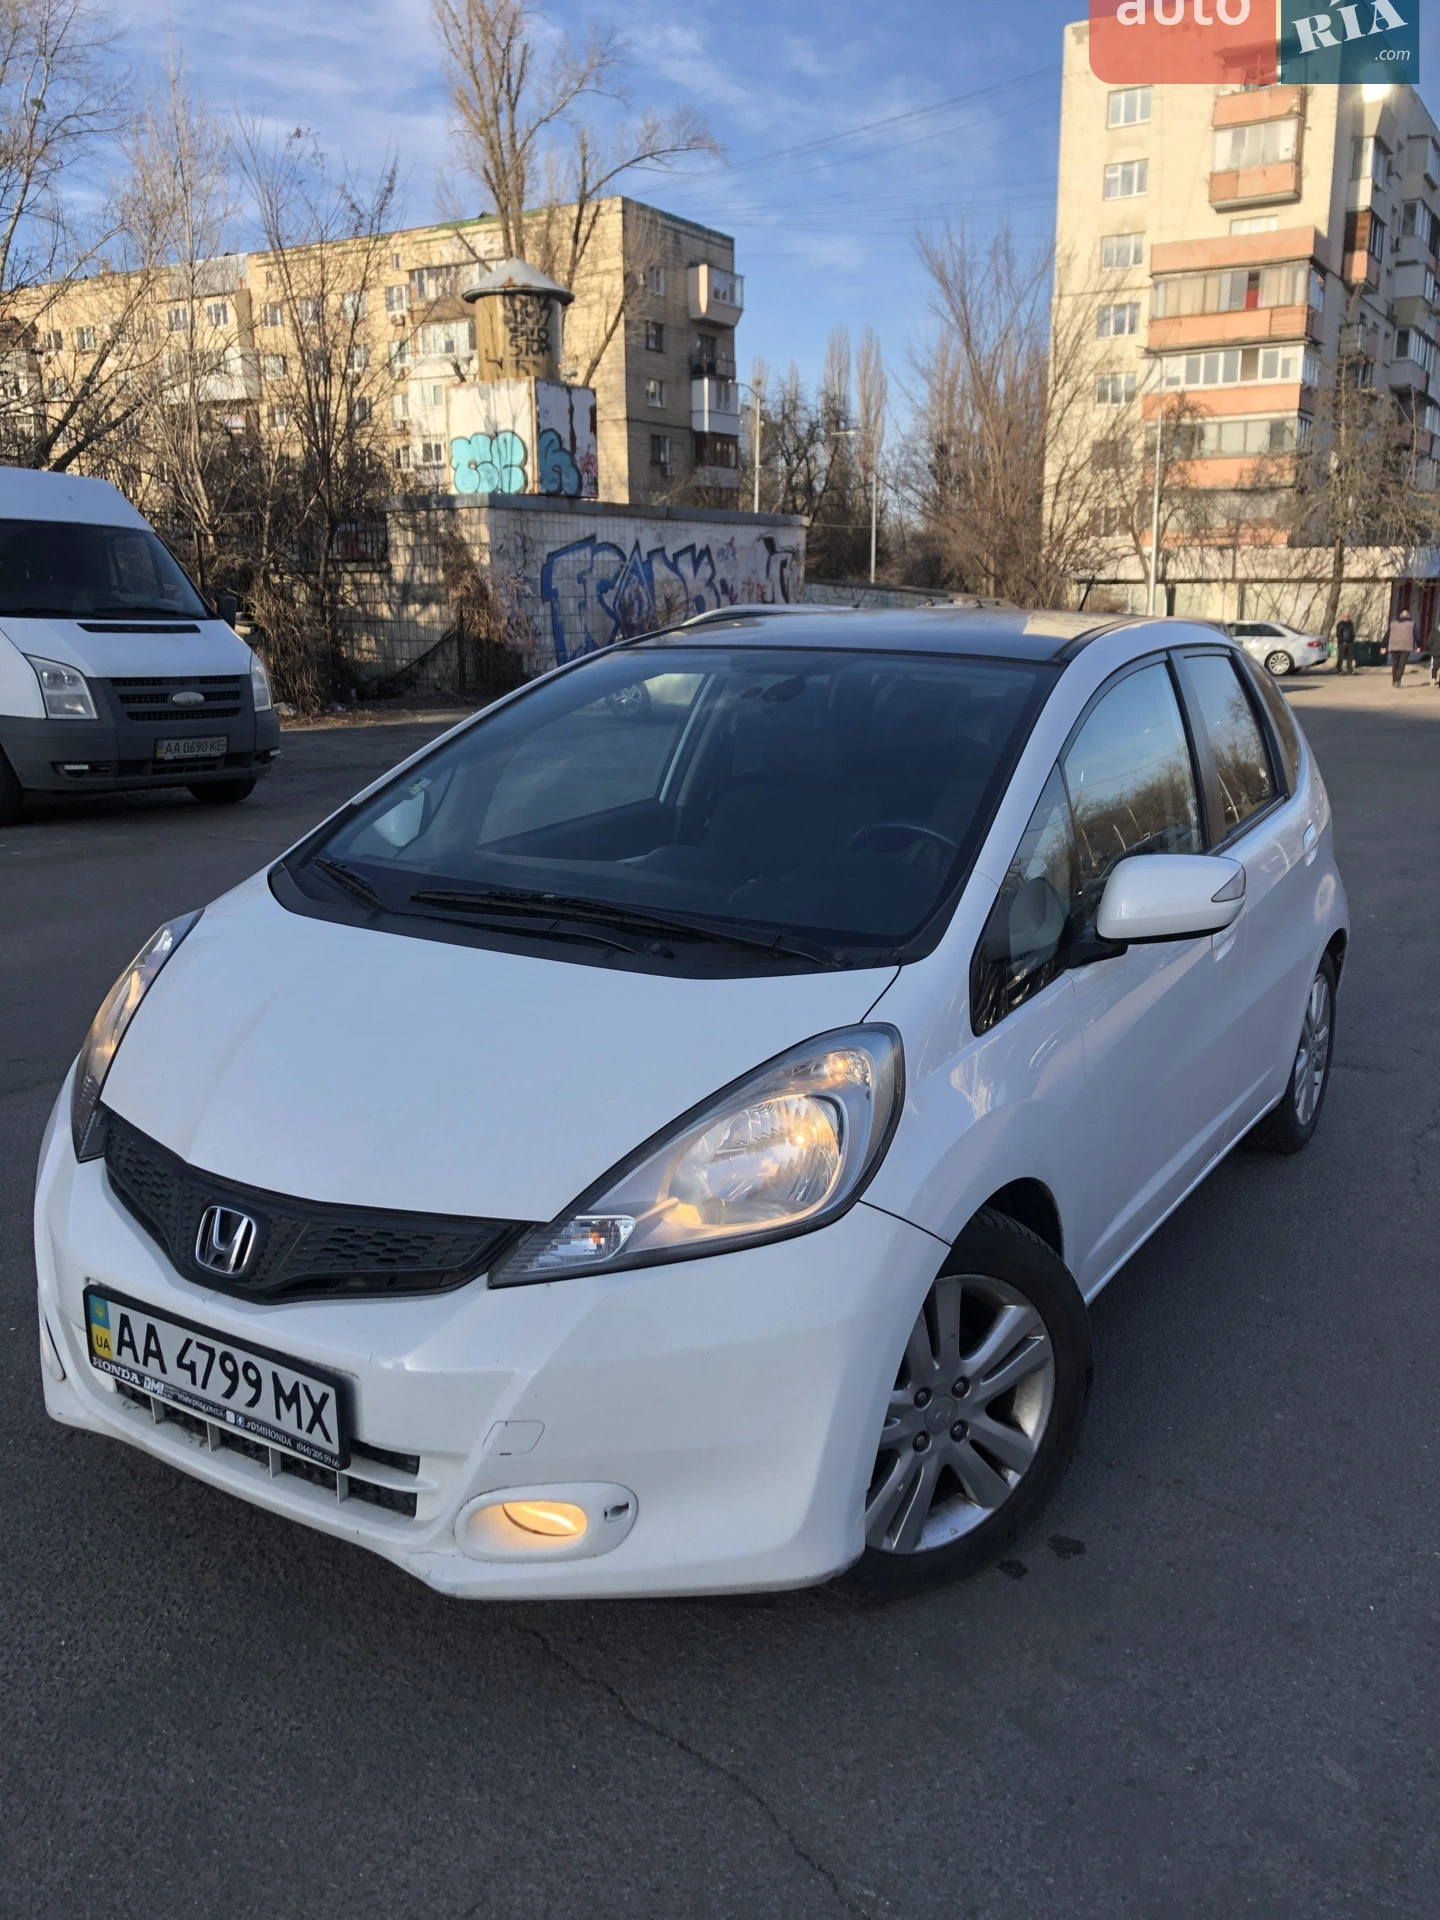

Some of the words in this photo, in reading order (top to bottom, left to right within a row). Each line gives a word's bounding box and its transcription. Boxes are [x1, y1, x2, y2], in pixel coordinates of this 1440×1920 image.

[164, 742, 181, 755] AA
[183, 740, 208, 754] 0690
[209, 739, 226, 752] KE
[95, 1334, 111, 1351] UA
[92, 1356, 141, 1385] HONDA
[116, 1312, 168, 1375] AA
[176, 1337, 263, 1408] 4799
[271, 1370, 333, 1445] MX
